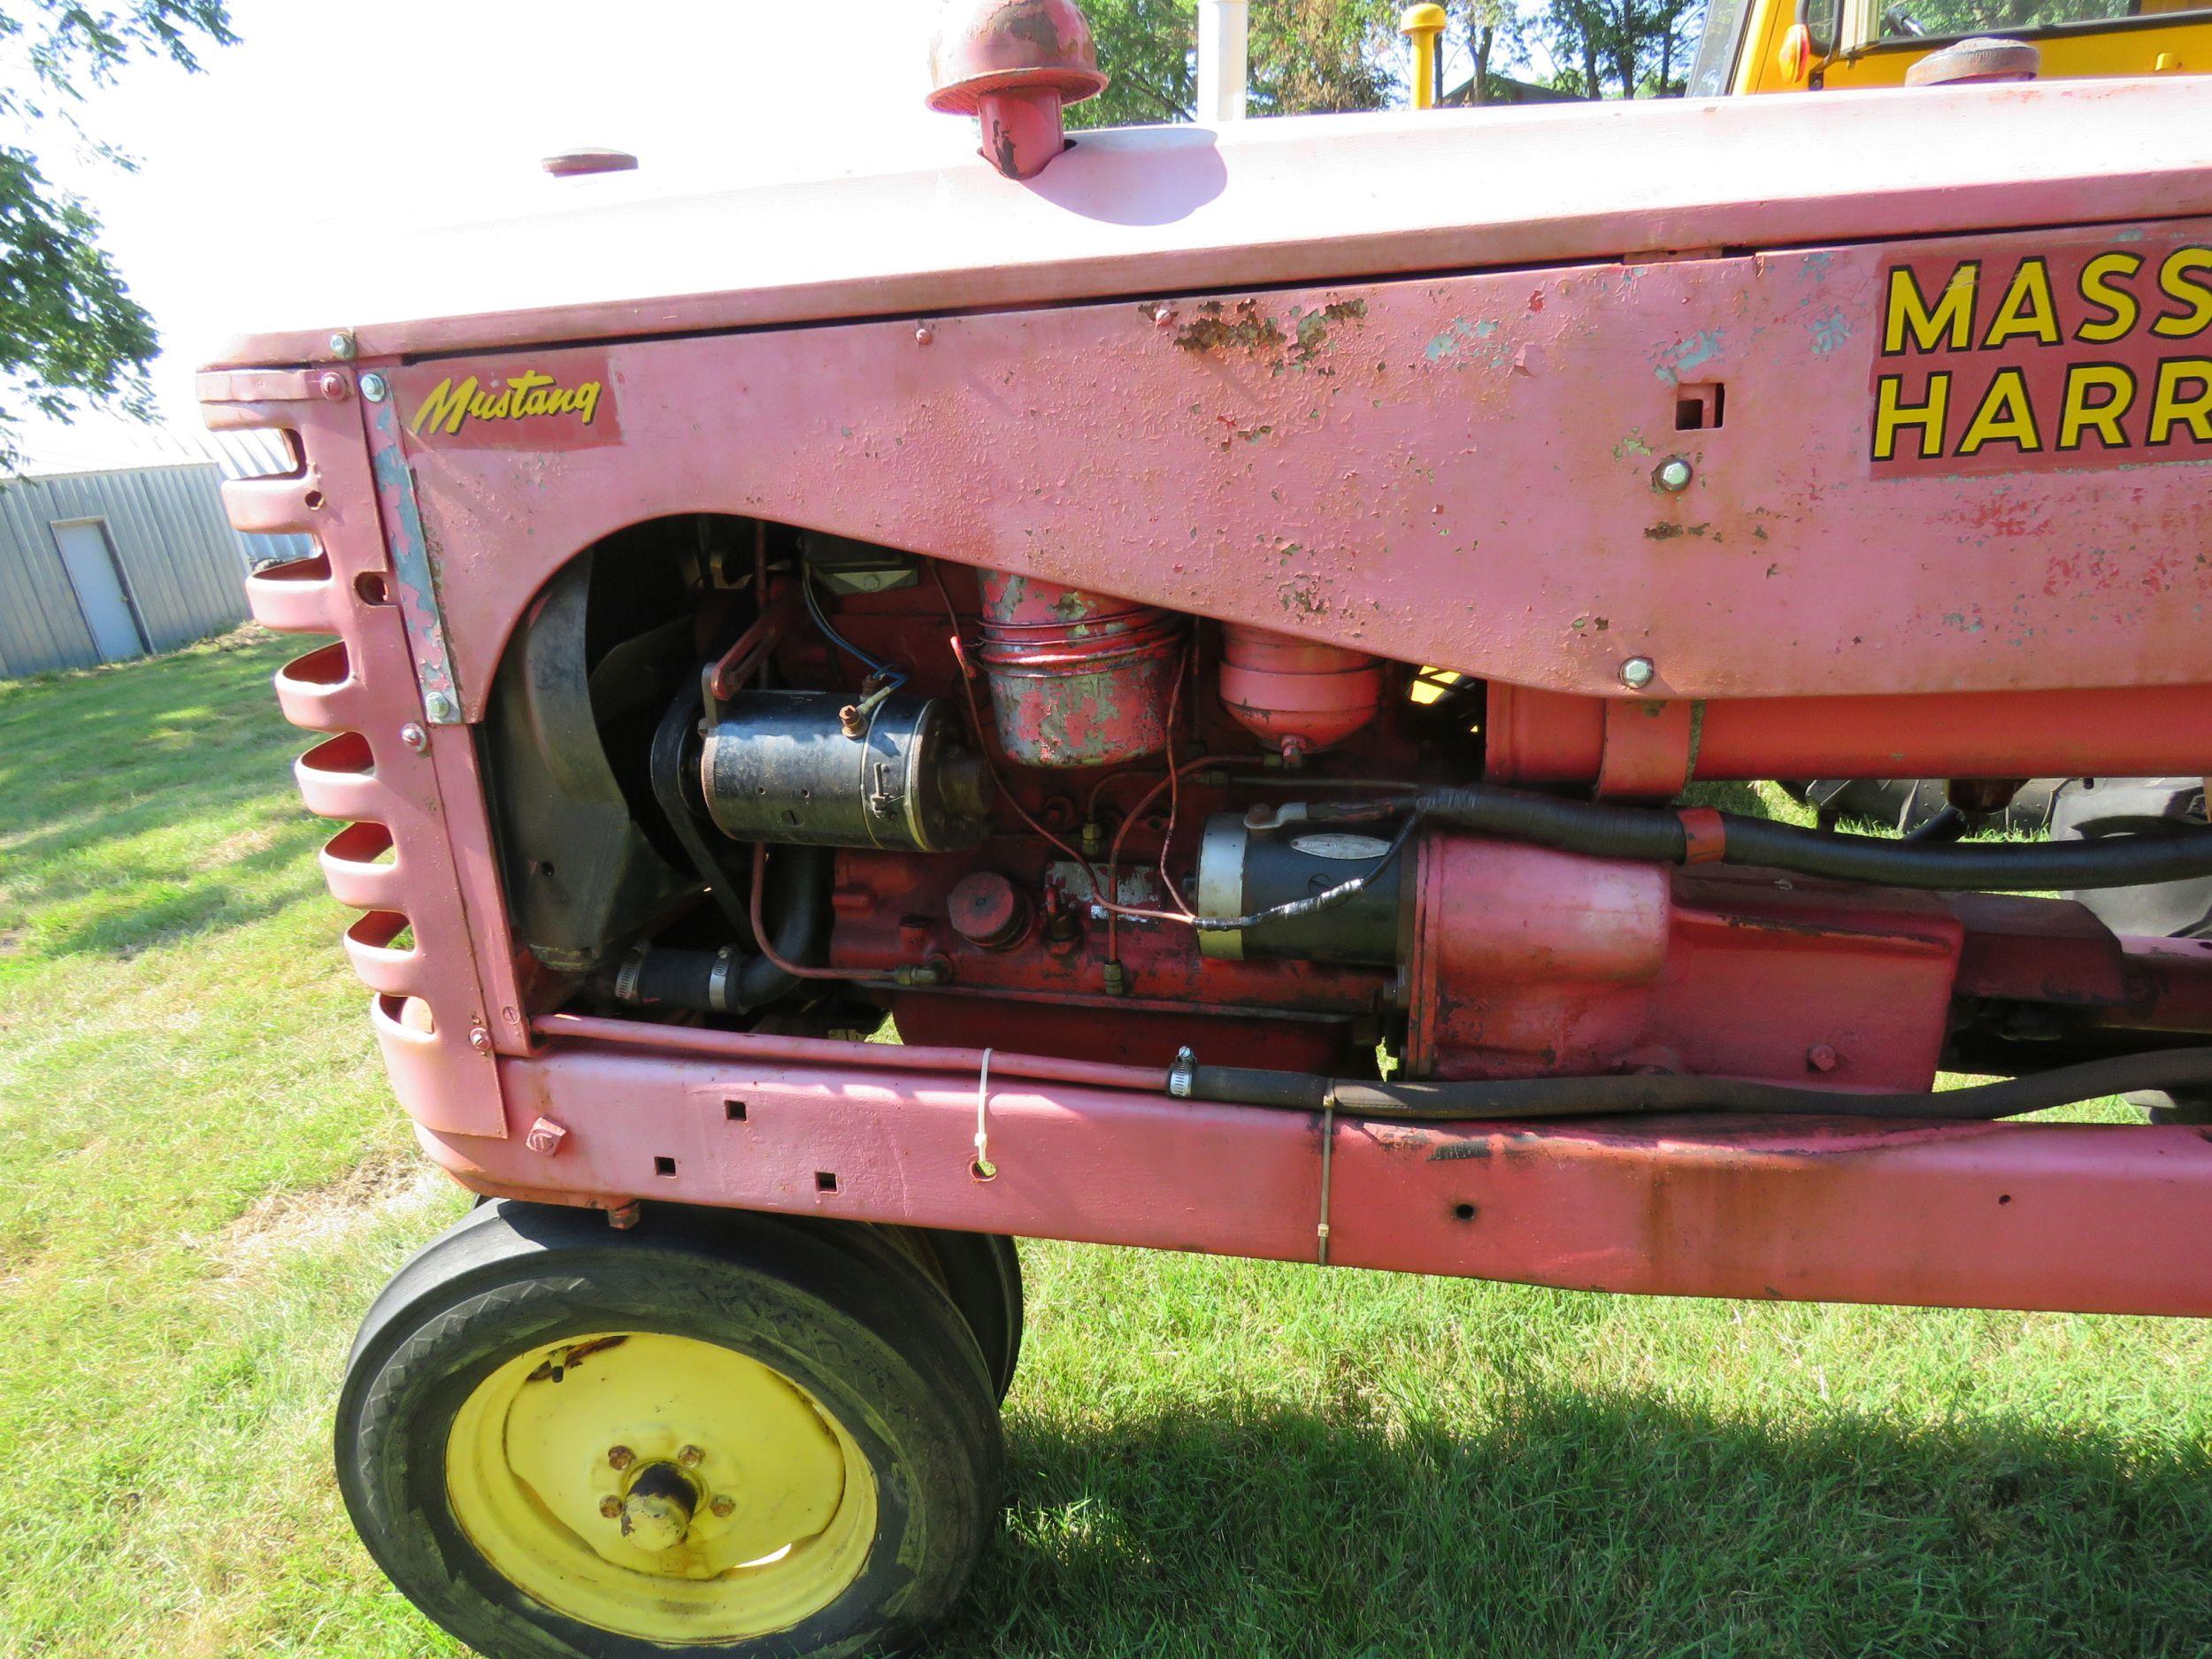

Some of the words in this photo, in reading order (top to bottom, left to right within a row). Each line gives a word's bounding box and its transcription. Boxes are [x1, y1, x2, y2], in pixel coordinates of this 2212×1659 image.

[1881, 244, 2212, 357] MASS
[411, 369, 603, 436] Mustang
[1870, 356, 2212, 462] HARR
